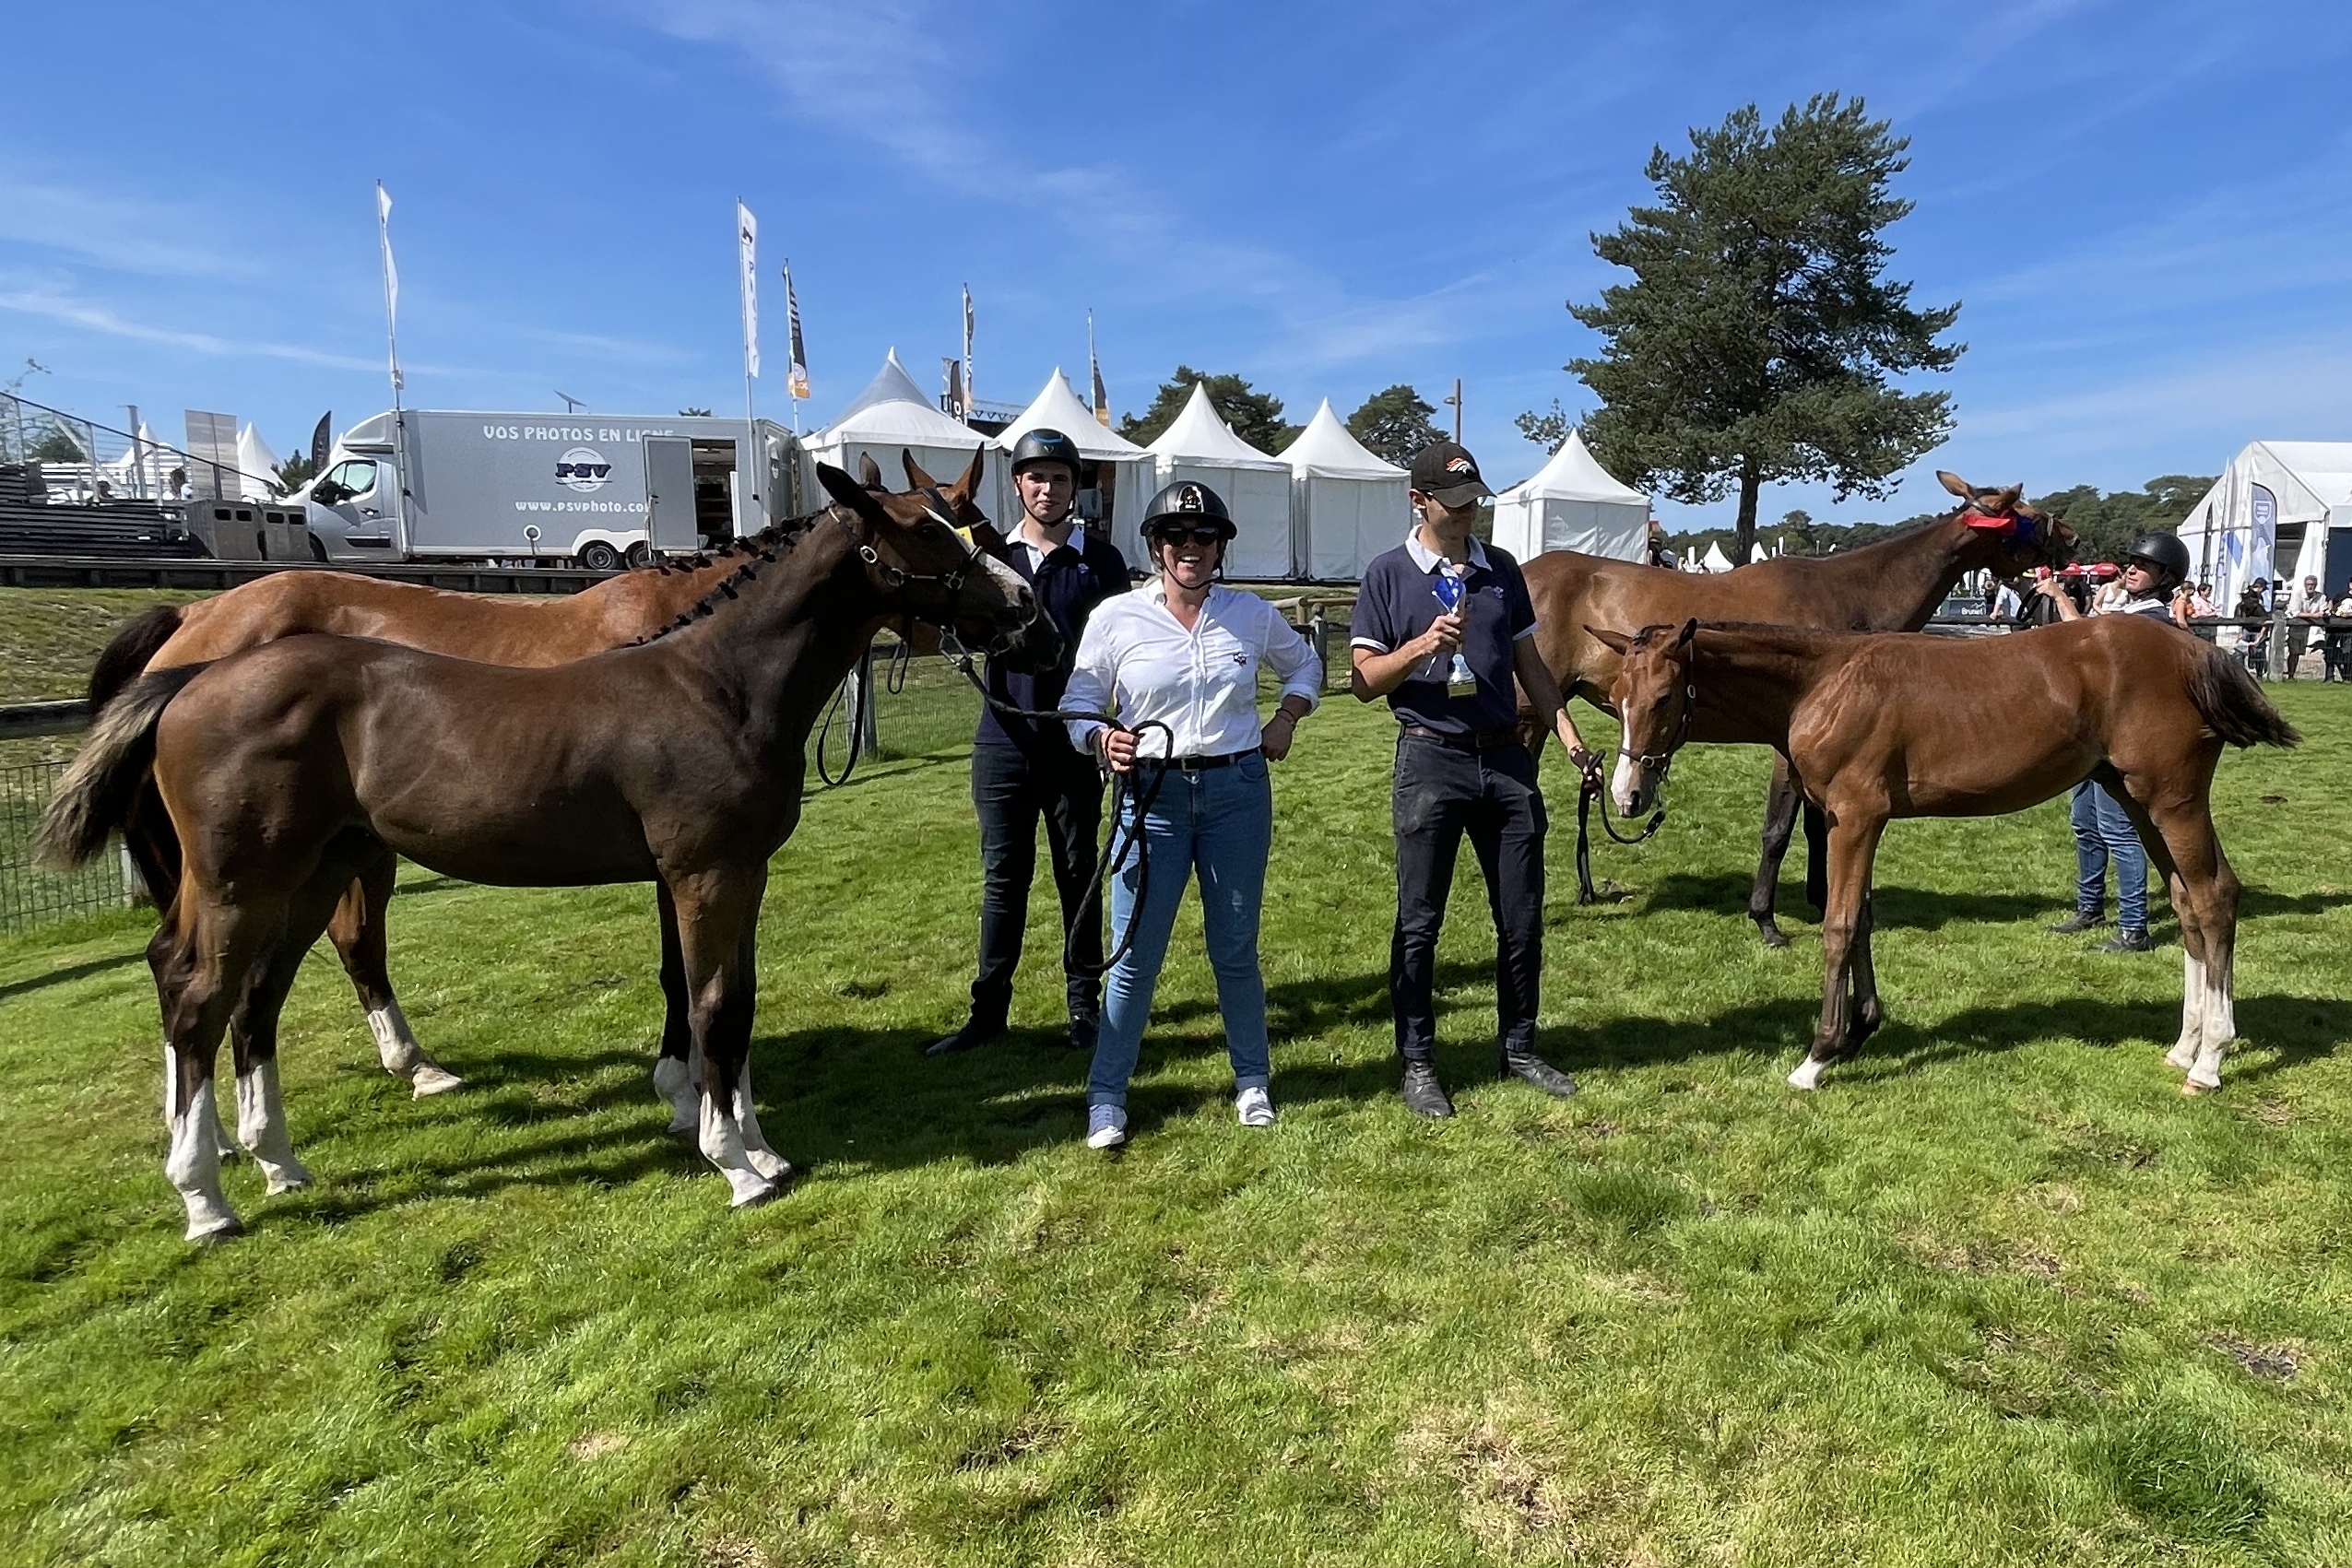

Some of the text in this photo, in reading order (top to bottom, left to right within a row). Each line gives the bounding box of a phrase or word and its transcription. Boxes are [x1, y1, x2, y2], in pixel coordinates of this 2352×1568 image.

[483, 425, 519, 440] VOS
[524, 427, 594, 442] PHOTOS
[599, 428, 621, 442] EN
[555, 463, 611, 478] PSV
[514, 500, 649, 513] www.psvphoto.co
